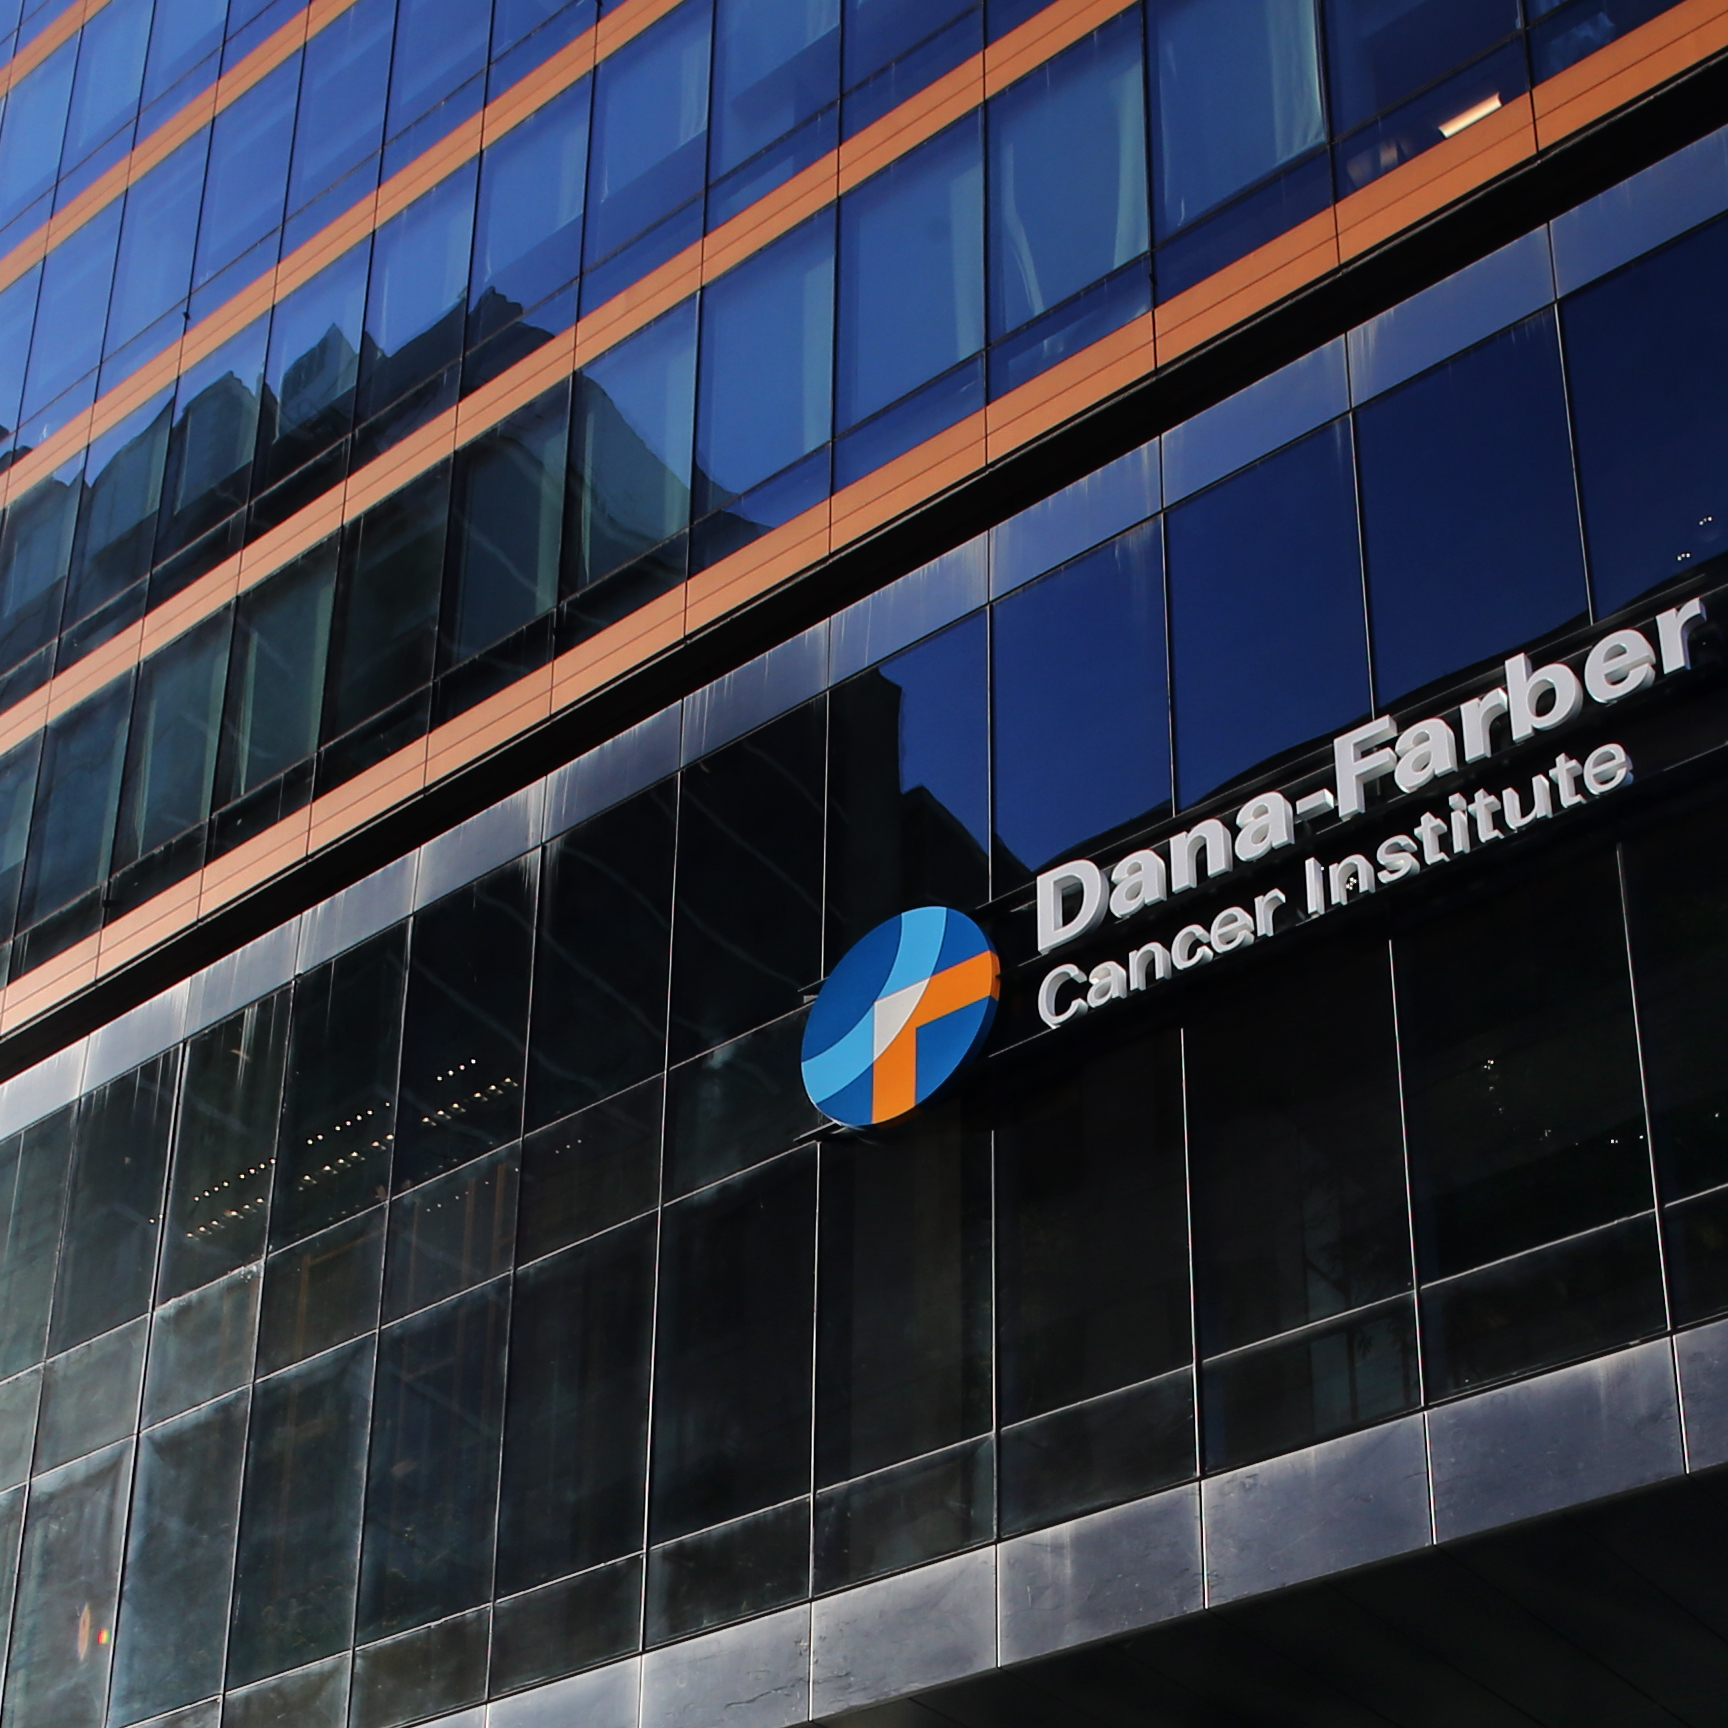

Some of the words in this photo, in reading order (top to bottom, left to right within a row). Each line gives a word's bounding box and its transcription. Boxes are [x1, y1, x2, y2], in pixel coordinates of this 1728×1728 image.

[1036, 596, 1708, 954] Dana-Farber
[1036, 886, 1288, 1029] Cancer
[1304, 743, 1634, 919] Institute
